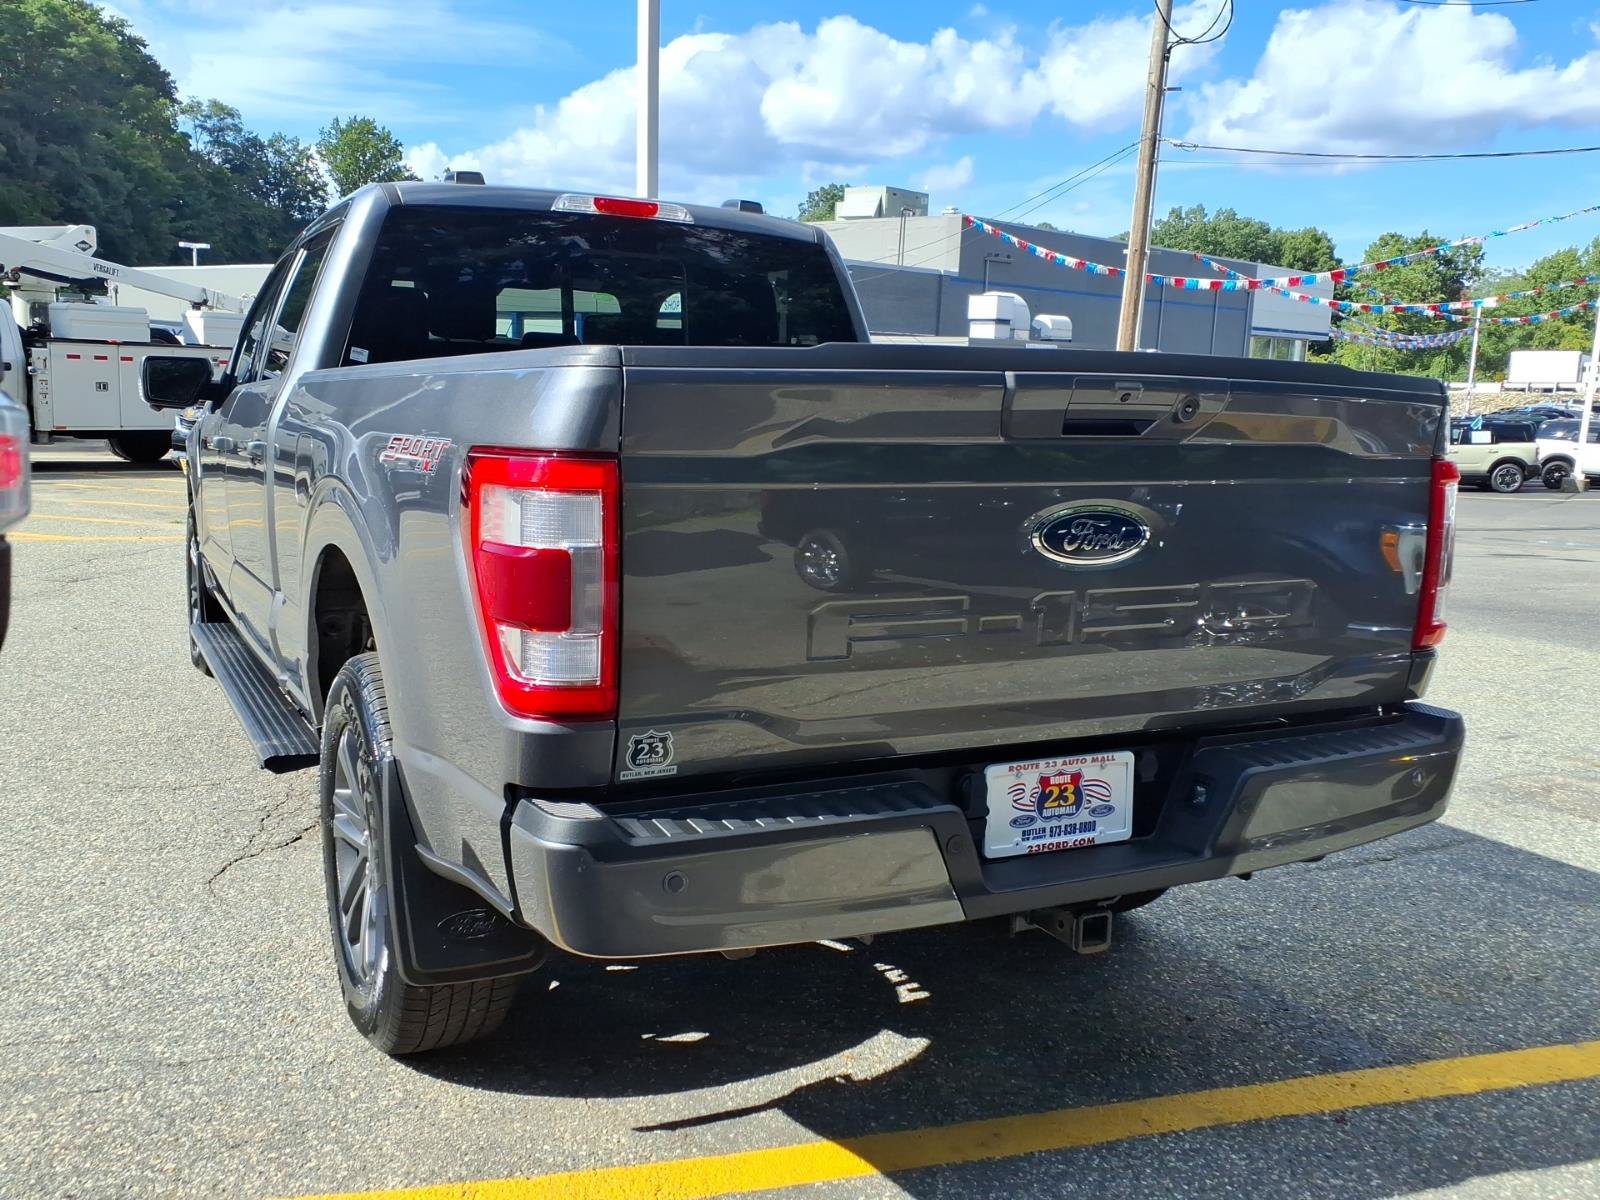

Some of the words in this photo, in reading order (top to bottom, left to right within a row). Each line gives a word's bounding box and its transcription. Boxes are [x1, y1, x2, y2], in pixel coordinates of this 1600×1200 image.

[93, 263, 119, 277] VERSALIFT
[380, 433, 452, 463] SPORT
[1063, 518, 1126, 551] Ford
[637, 743, 664, 759] 23
[1008, 763, 1040, 772] ROUTE
[1044, 760, 1057, 769] 23
[1060, 757, 1088, 767] AUTO
[1090, 754, 1116, 764] MALL
[1050, 775, 1072, 785] ROUTE
[1044, 783, 1076, 808] 23
[1042, 805, 1076, 817] AUTOMALL
[1021, 827, 1046, 837] BUTLER
[1027, 837, 1095, 853] 23FORD.COM
